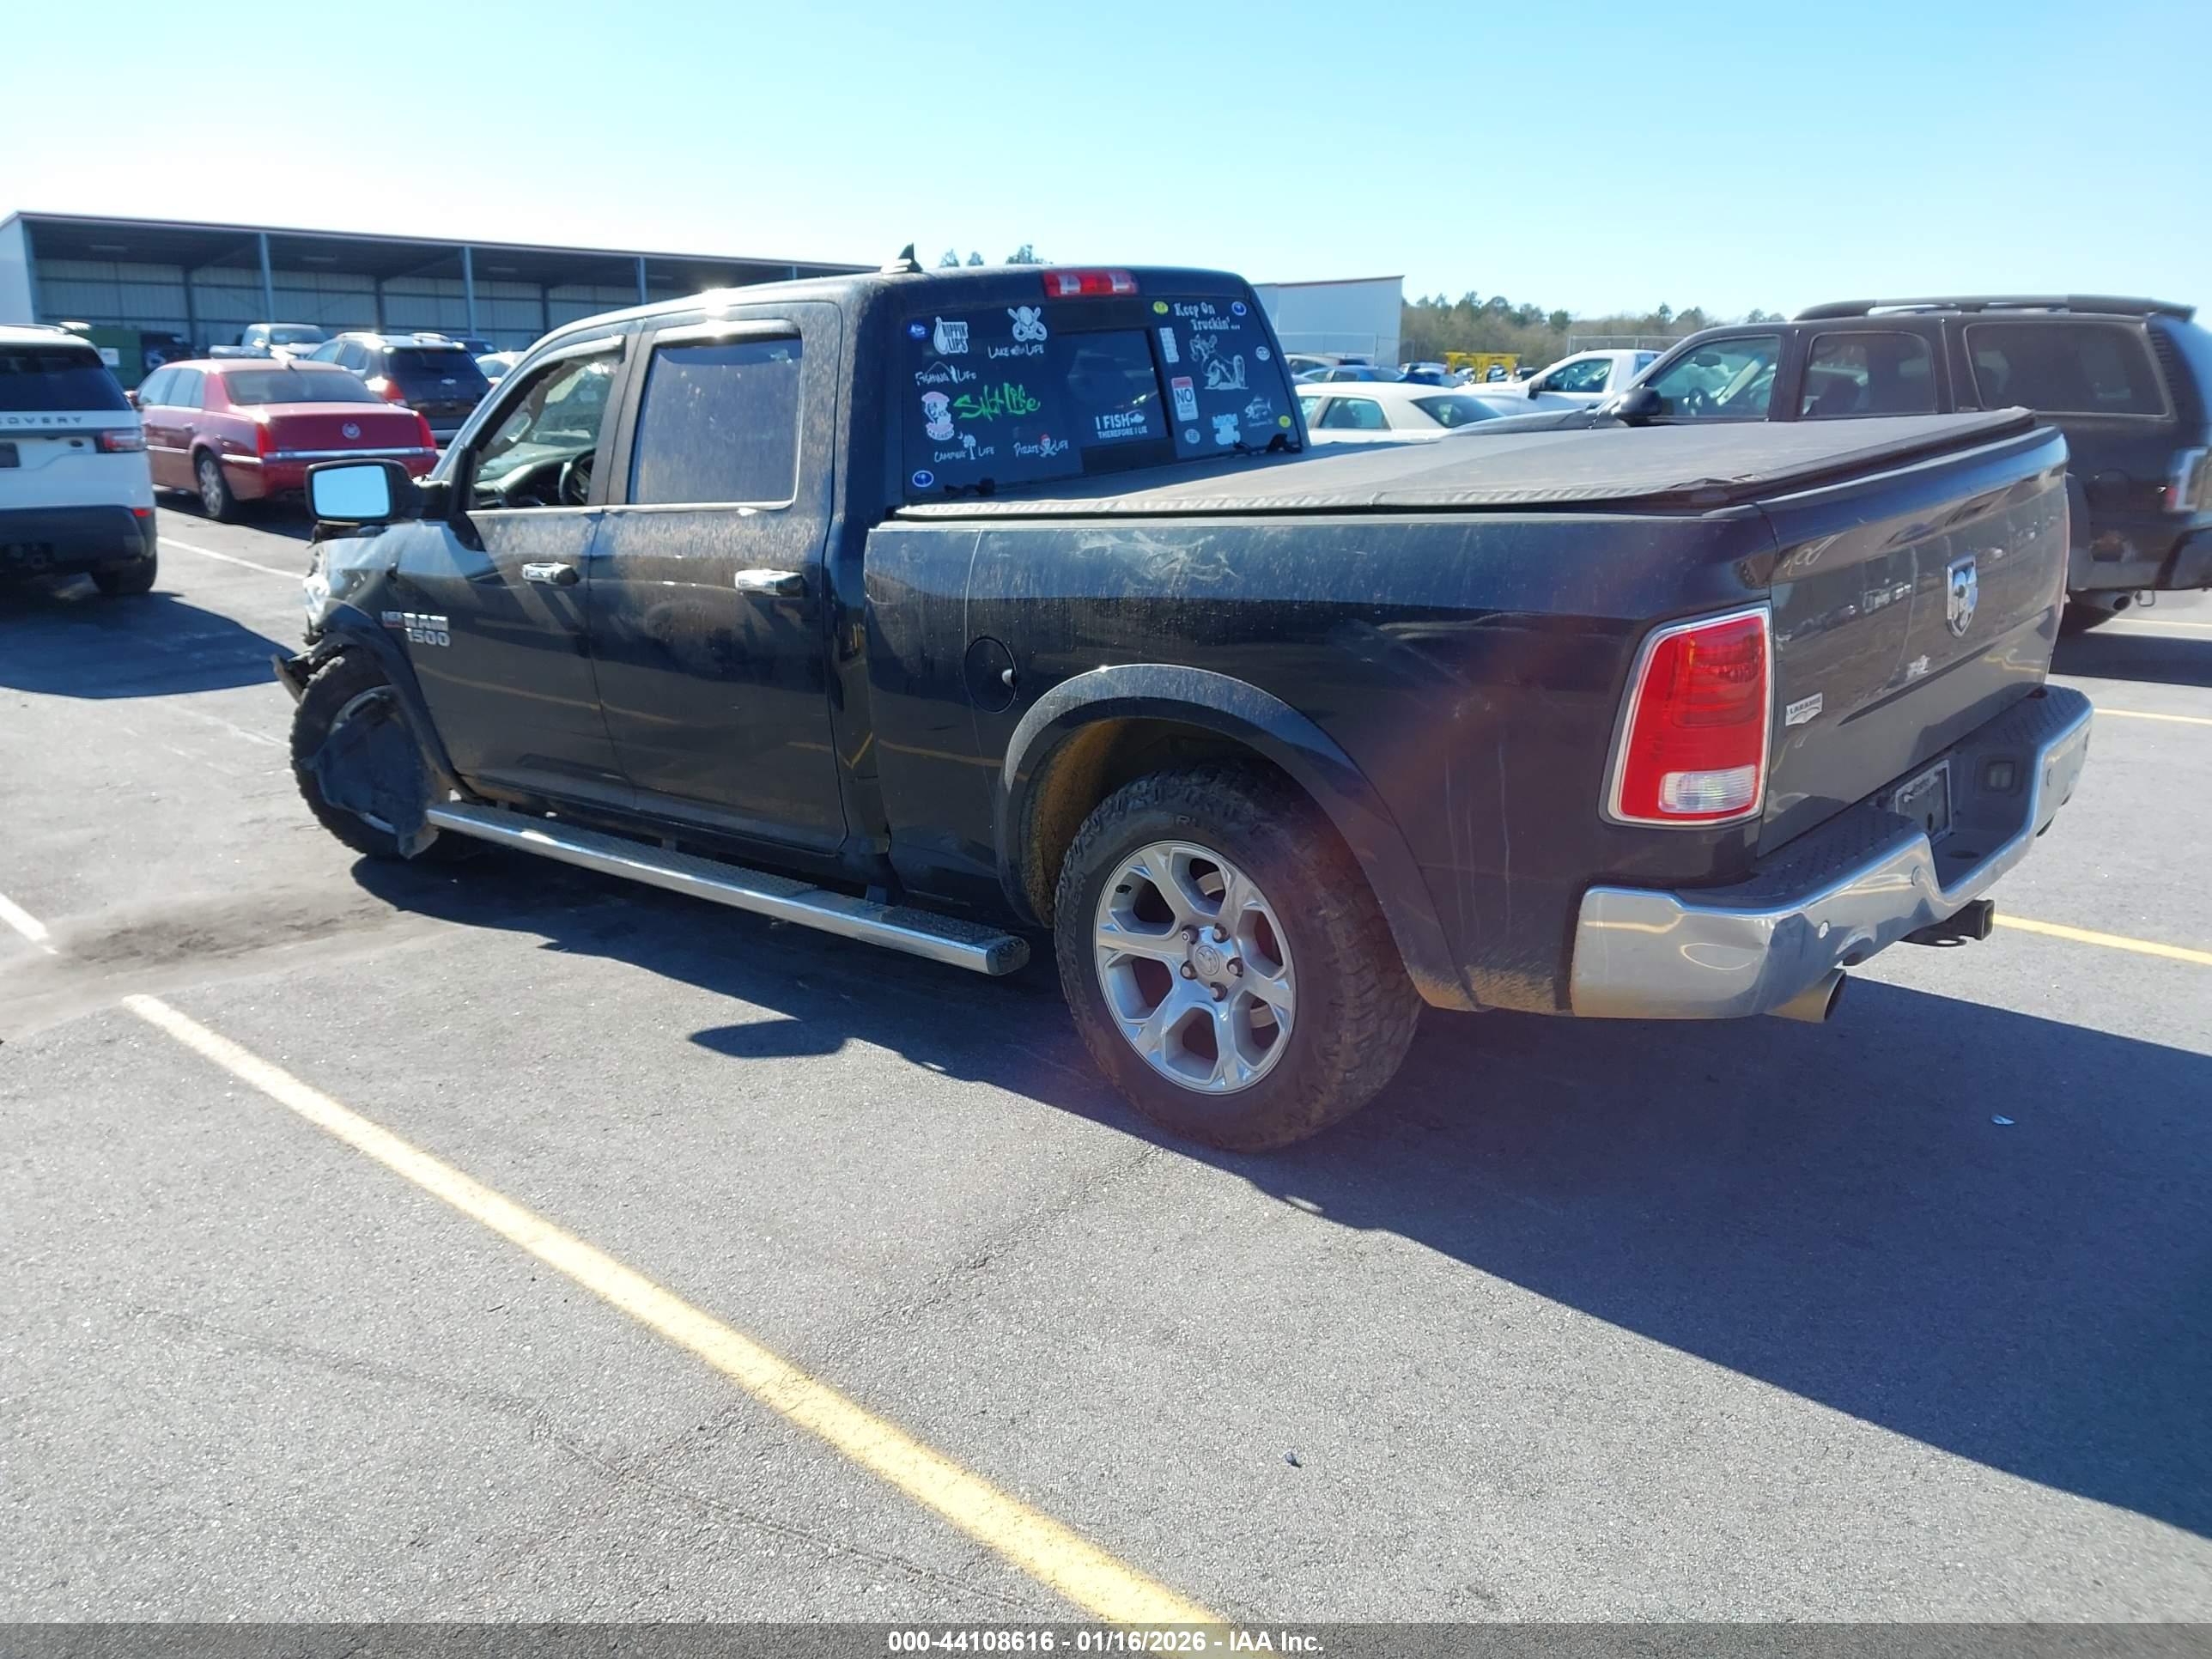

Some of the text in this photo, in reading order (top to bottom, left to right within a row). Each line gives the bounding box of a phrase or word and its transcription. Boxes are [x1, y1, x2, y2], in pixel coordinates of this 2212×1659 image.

[1174, 301, 1216, 319] Keep On
[1176, 388, 1194, 404] NO
[1103, 413, 1130, 429] FISH
[405, 627, 450, 647] 1500
